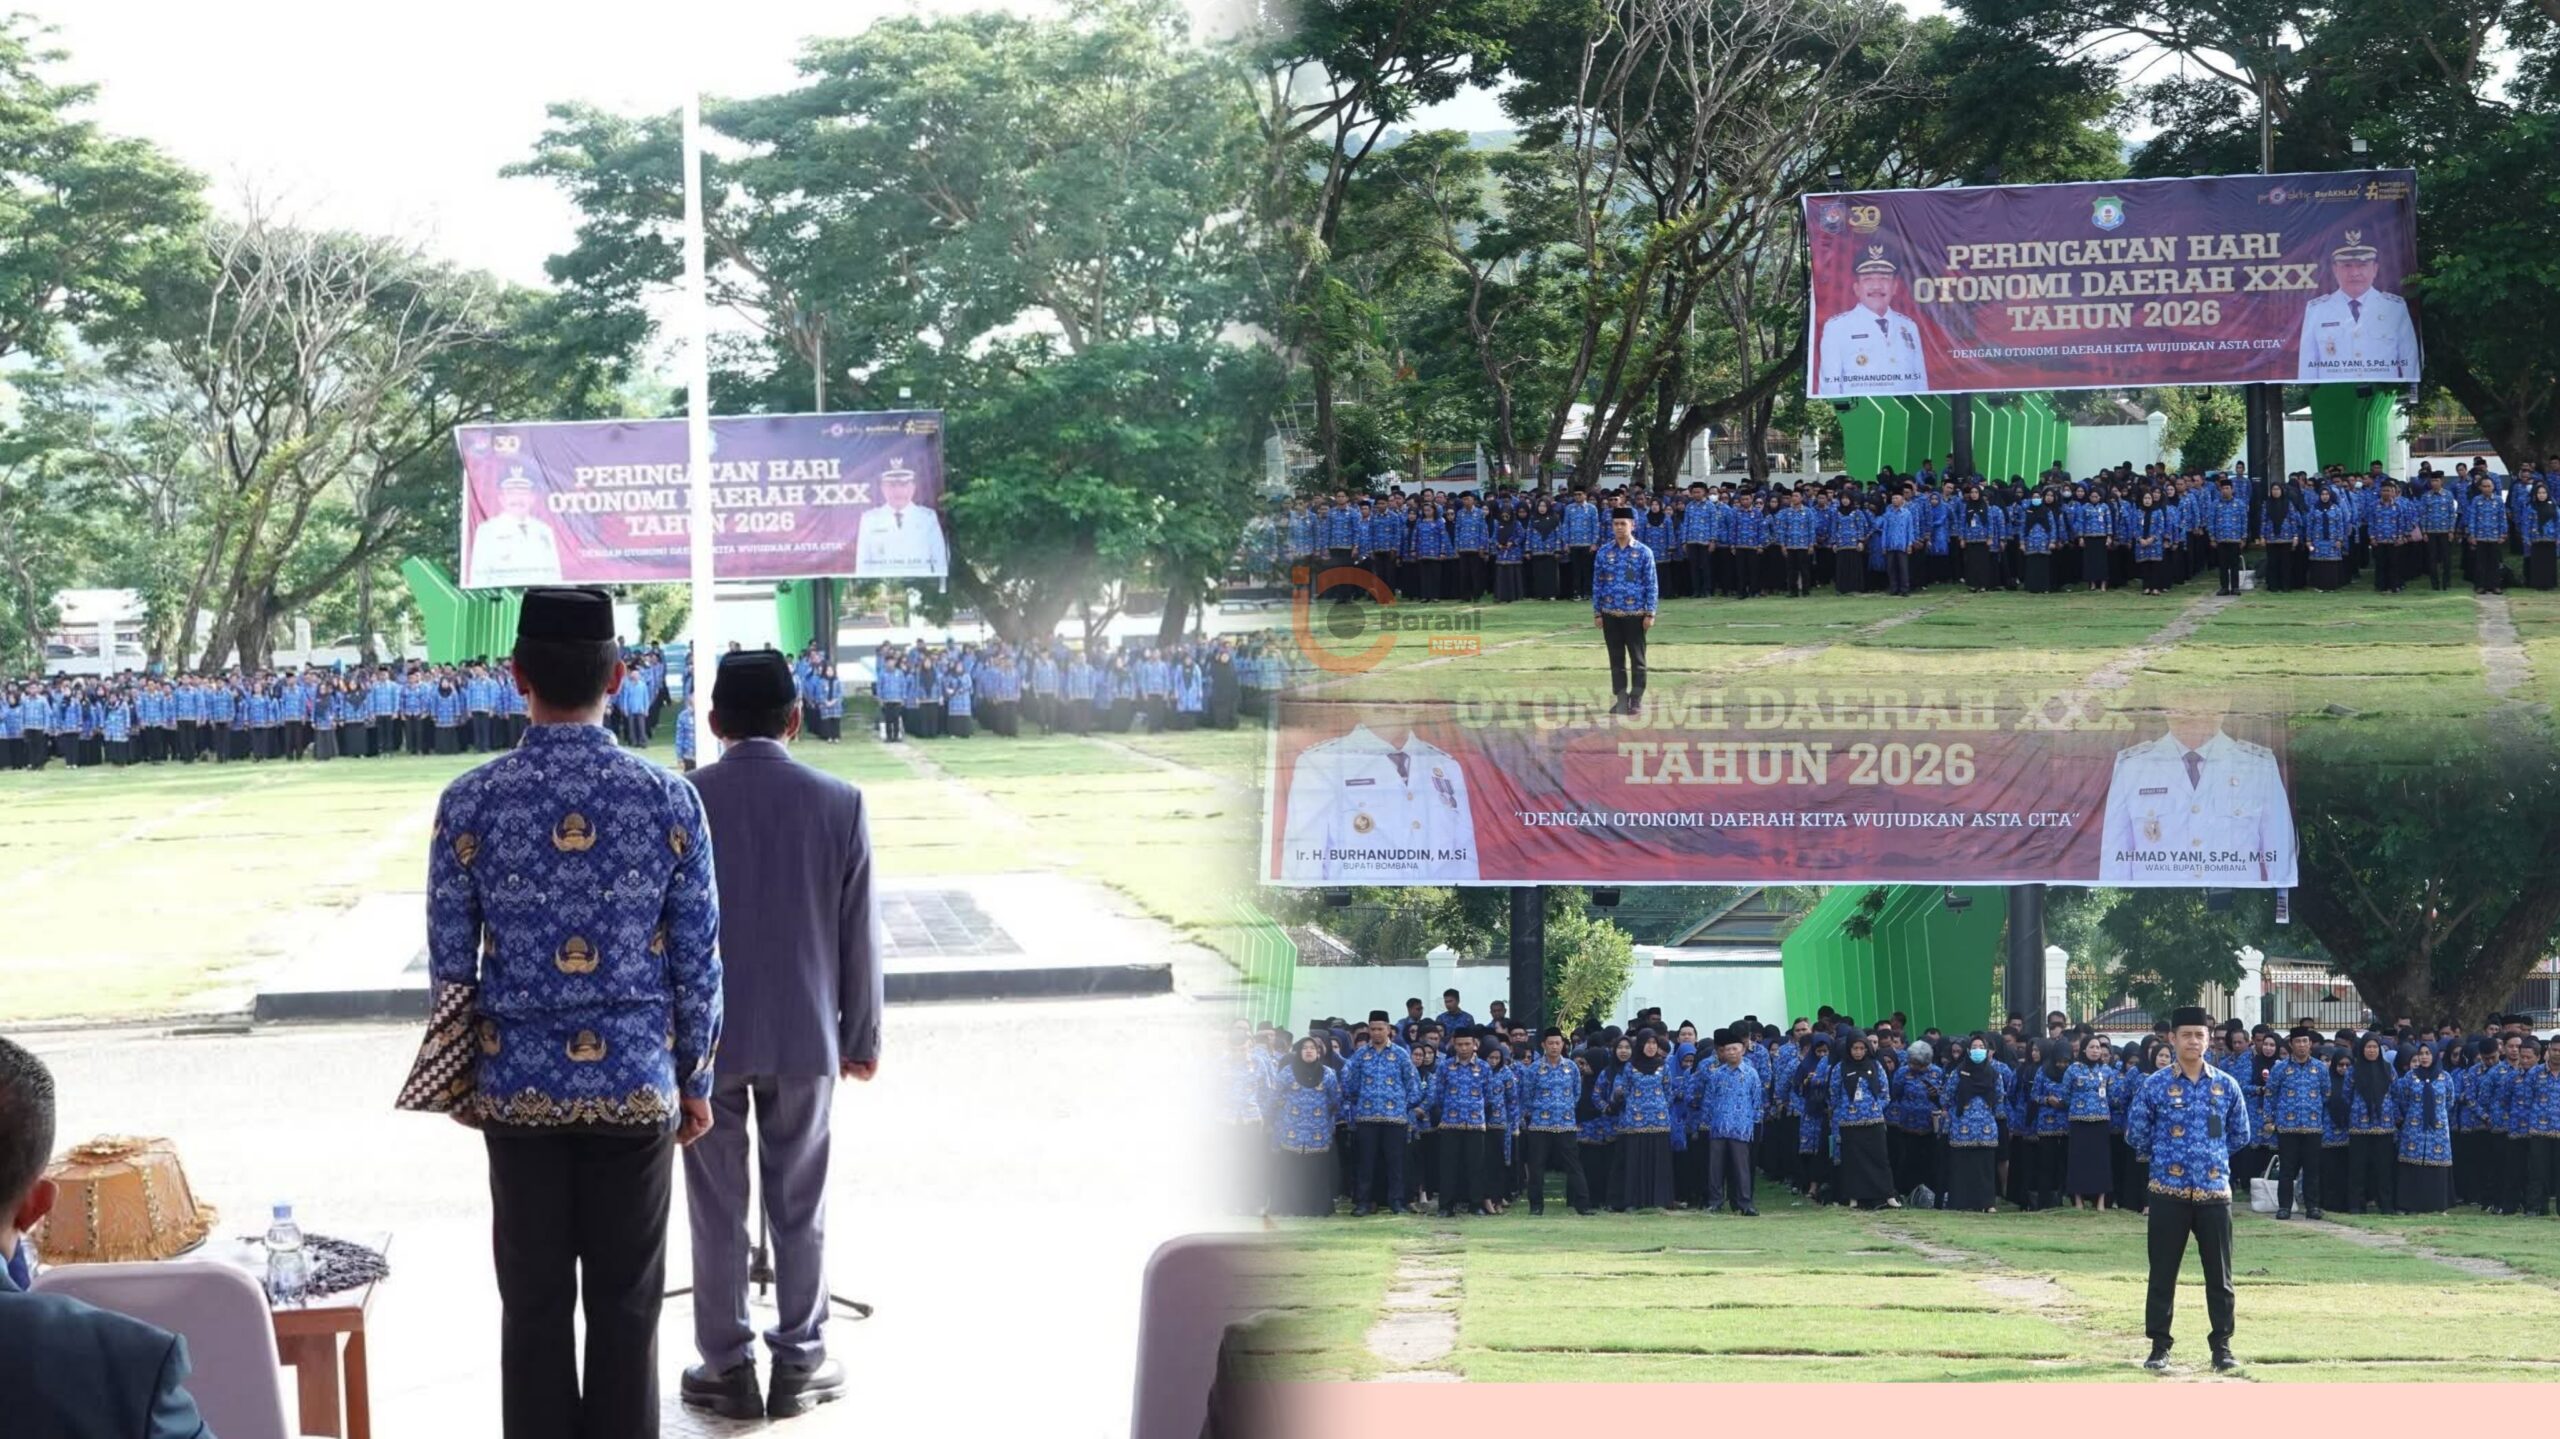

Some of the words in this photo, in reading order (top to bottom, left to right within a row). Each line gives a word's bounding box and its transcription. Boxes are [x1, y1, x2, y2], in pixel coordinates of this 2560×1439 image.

[1946, 236, 2178, 270] PERINGATAN
[2187, 233, 2281, 260] HARI
[1914, 272, 2072, 303] OTONOMI
[2081, 267, 2235, 297] DAERAH
[2243, 263, 2318, 291] XXX
[2007, 303, 2134, 331] TAHUN
[2143, 300, 2221, 327] 2026
[2005, 346, 2058, 357] OTONOMI
[2061, 344, 2112, 355] DAERAH
[2115, 343, 2143, 353] KITA
[2147, 341, 2215, 352] WUJUDKAN
[2219, 340, 2250, 350] ASTA
[2308, 360, 2340, 368] AHMAD
[767, 458, 841, 481] HARI
[548, 488, 677, 514] OTONOMI
[811, 483, 871, 504] XXX
[624, 511, 728, 536] TAHN
[734, 510, 795, 533] 2026
[1455, 685, 1729, 730] OTONOMI
[1744, 686, 1999, 730] DAERAH
[2014, 687, 2135, 731] XXX
[1618, 742, 1832, 785] TAHUN
[1848, 742, 1975, 785] 2026
[1613, 812, 1704, 827] OTONOMI
[1709, 812, 1796, 827] DAERAH
[1800, 812, 1847, 827] KITA
[1852, 812, 1965, 828] WUJUDKAN
[1973, 812, 2023, 827] ASTA
[1296, 849, 1309, 860] Ir.
[1313, 849, 1326, 860] H.
[1329, 849, 1434, 862] BURHANUDDIN,
[1438, 848, 1467, 860] M.Si
[1375, 862, 1419, 870] BOMBANA
[2115, 850, 2166, 862] AHMAD
[2170, 850, 2206, 863] YANI,
[2209, 850, 2246, 863] S.Pd.,
[2145, 864, 2171, 872] WAKIL
[2173, 864, 2201, 872] BUPATI
[2204, 863, 2247, 872] BOMBANA
